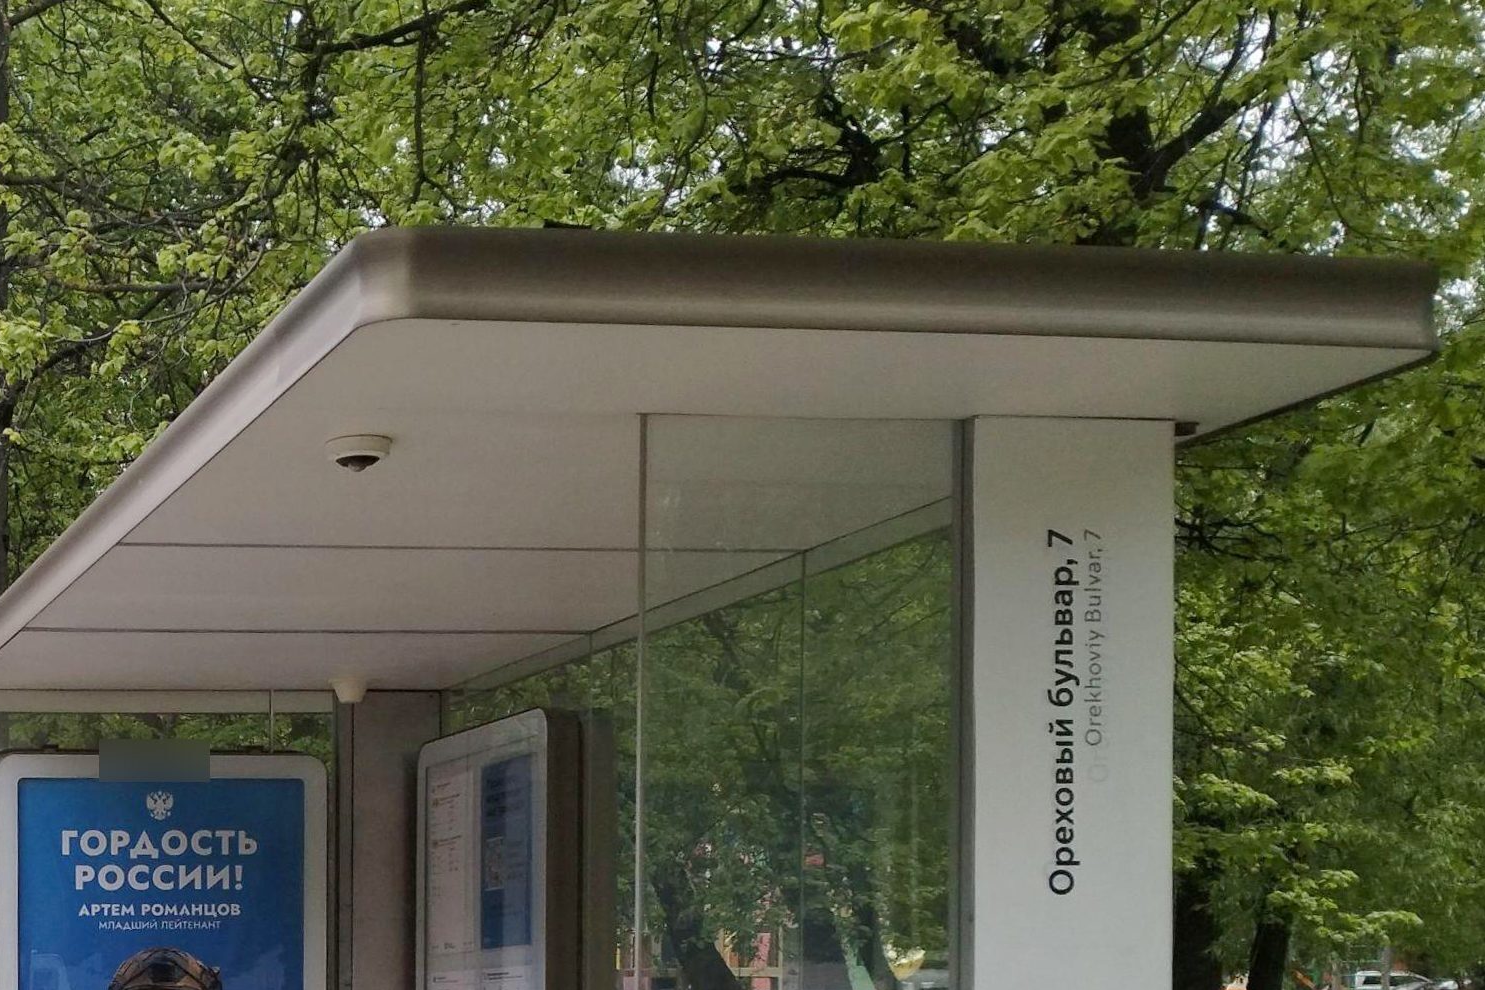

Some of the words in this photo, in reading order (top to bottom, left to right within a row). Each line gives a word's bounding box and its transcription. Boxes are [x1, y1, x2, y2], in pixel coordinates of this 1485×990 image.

[1047, 529, 1073, 547] 7
[1083, 529, 1101, 541] 7
[1083, 548, 1103, 623] Bulvar,
[1047, 558, 1080, 707] бульвар,
[1084, 629, 1105, 746] Orekhoviy
[1048, 719, 1080, 896] Ореховый
[61, 829, 258, 859] ГОРДОСТЬ
[74, 864, 244, 891] РОССИИ!
[78, 903, 135, 917] АРТЕМ
[141, 903, 241, 918] РОМАНЦОВ
[98, 919, 158, 930] МЛАДШИЙ
[161, 919, 221, 930] ЛЕЙТЕНАНТ
